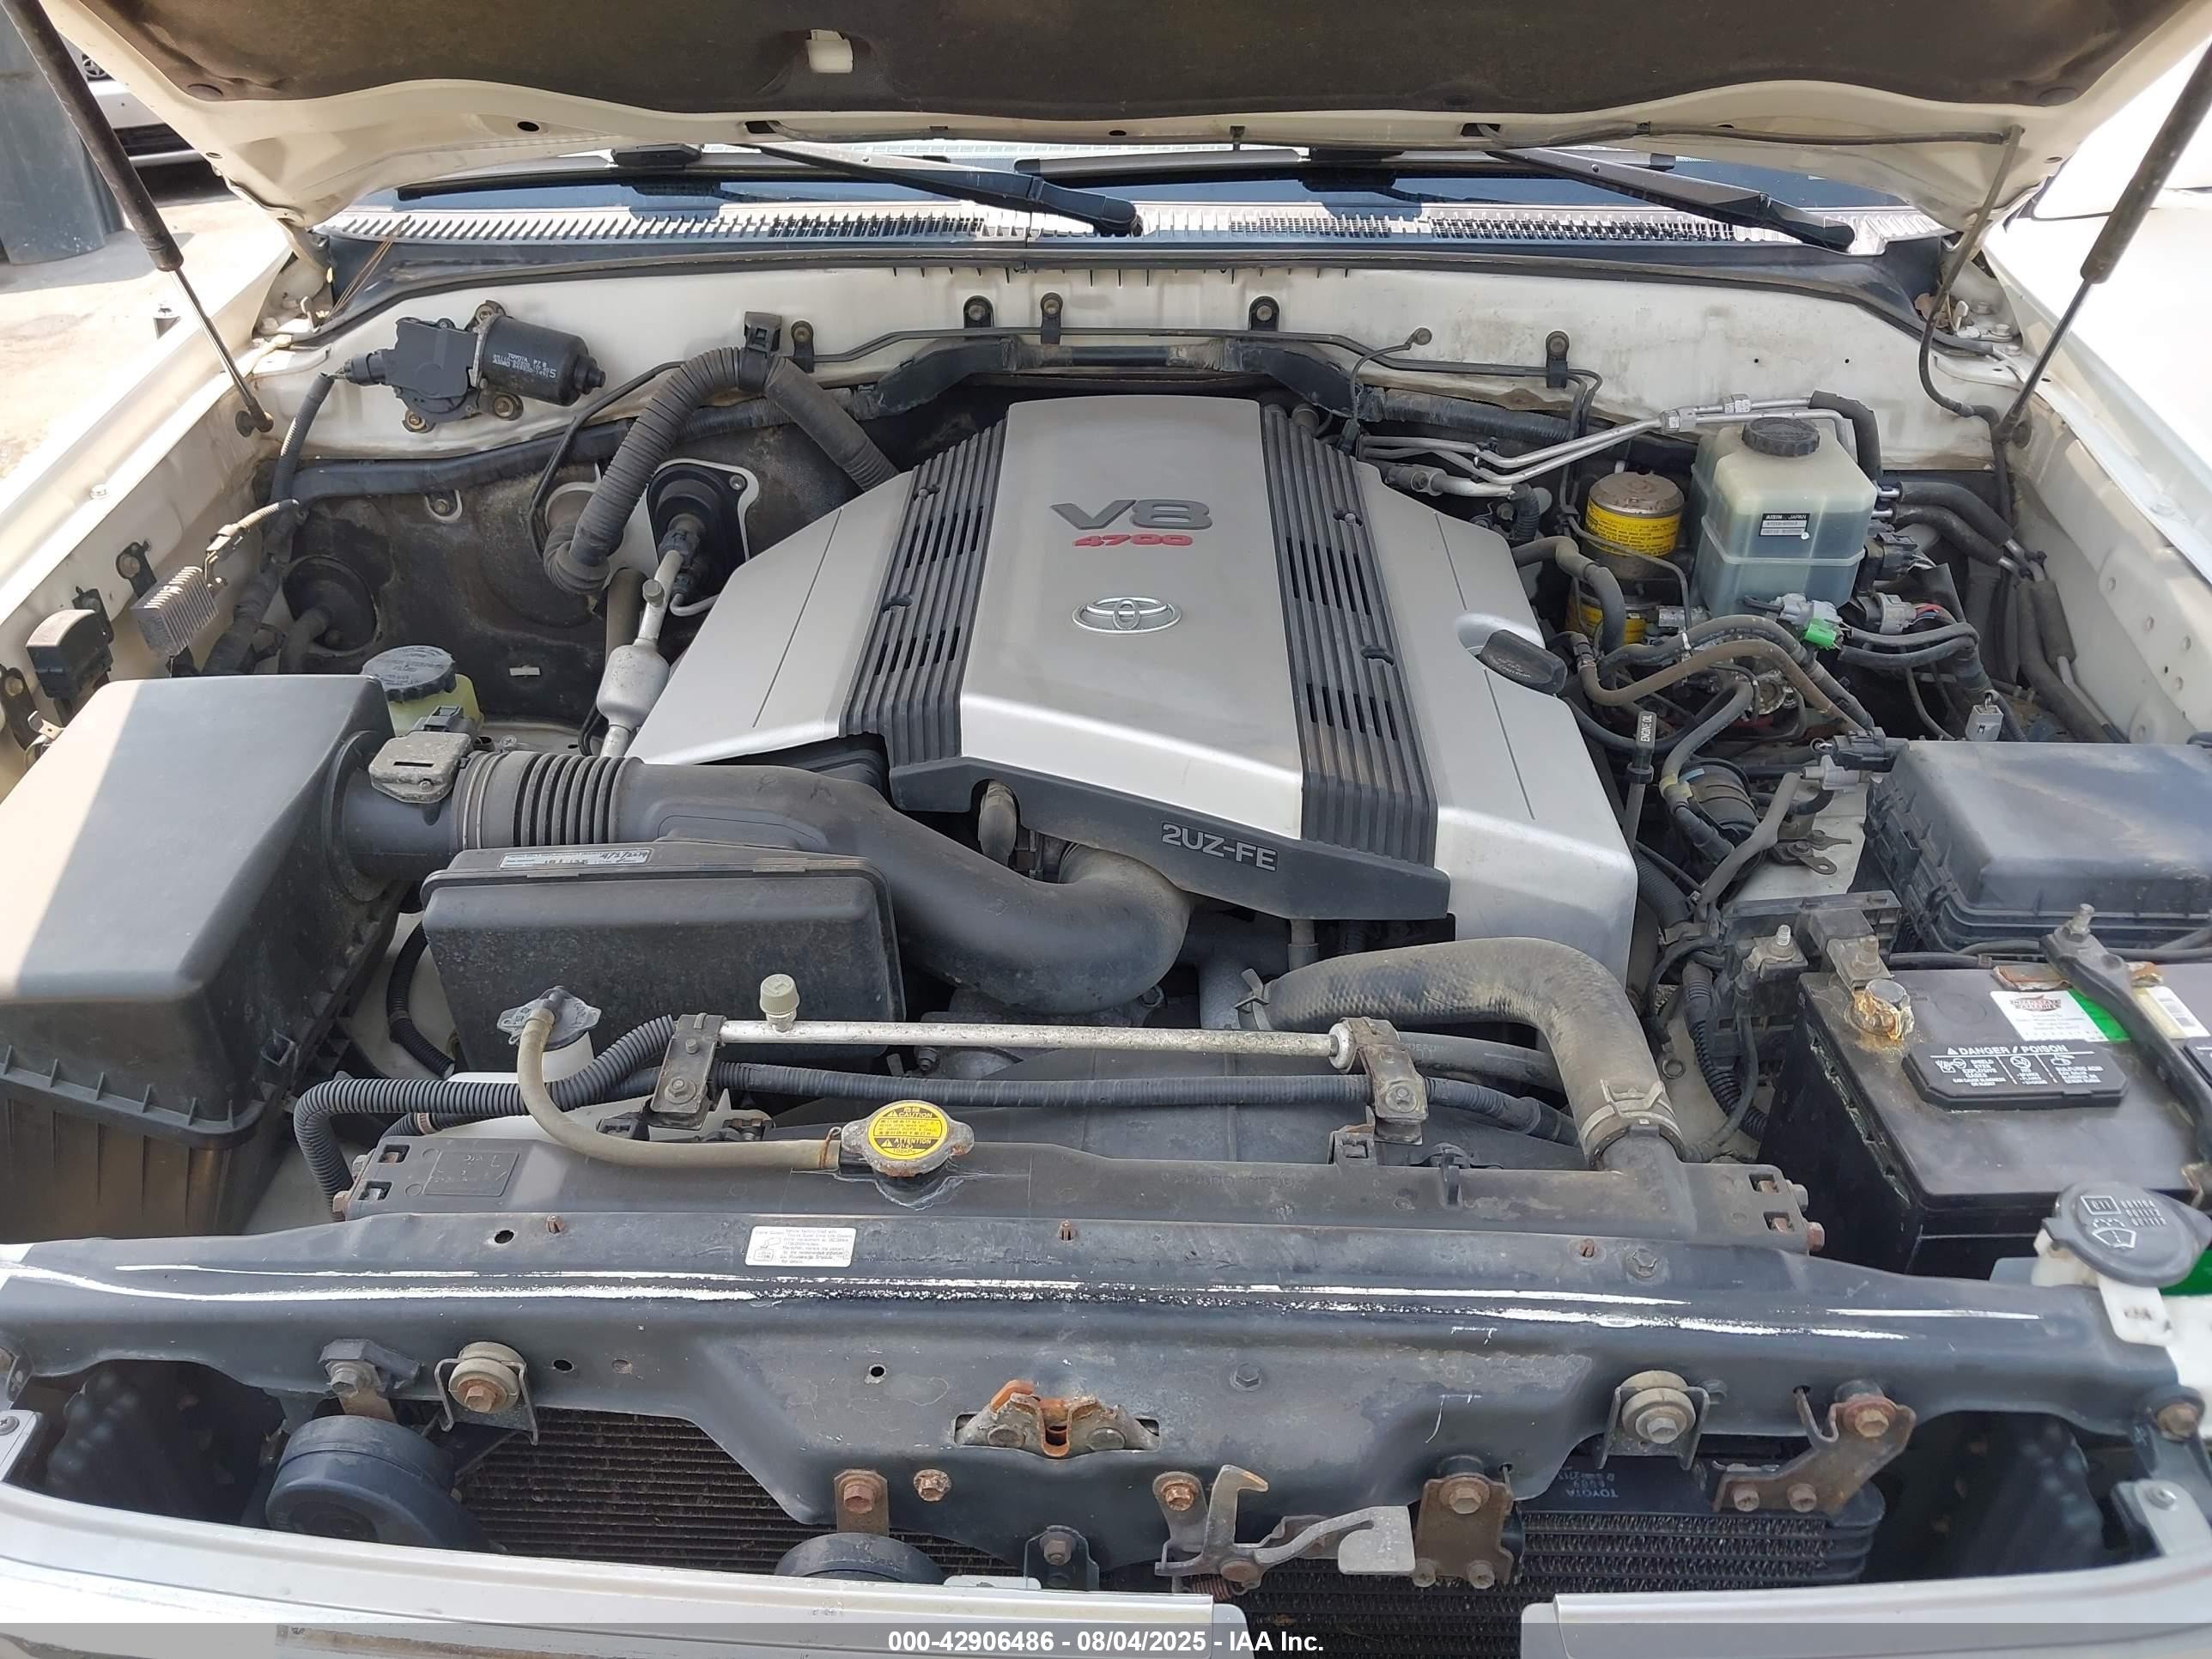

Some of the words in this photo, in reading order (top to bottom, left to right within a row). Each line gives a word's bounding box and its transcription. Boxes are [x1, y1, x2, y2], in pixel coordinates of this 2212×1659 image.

[507, 353, 528, 362] TOYOTA
[1049, 498, 1213, 530] V8
[1073, 533, 1194, 547] 4700
[1640, 722, 1651, 742] ENGINE
[1162, 823, 1277, 872] 2UZ-FE
[1958, 1046, 2010, 1055] DANGER
[2020, 1044, 2069, 1054] POISON
[1565, 1489, 1619, 1498] TOYOTA
